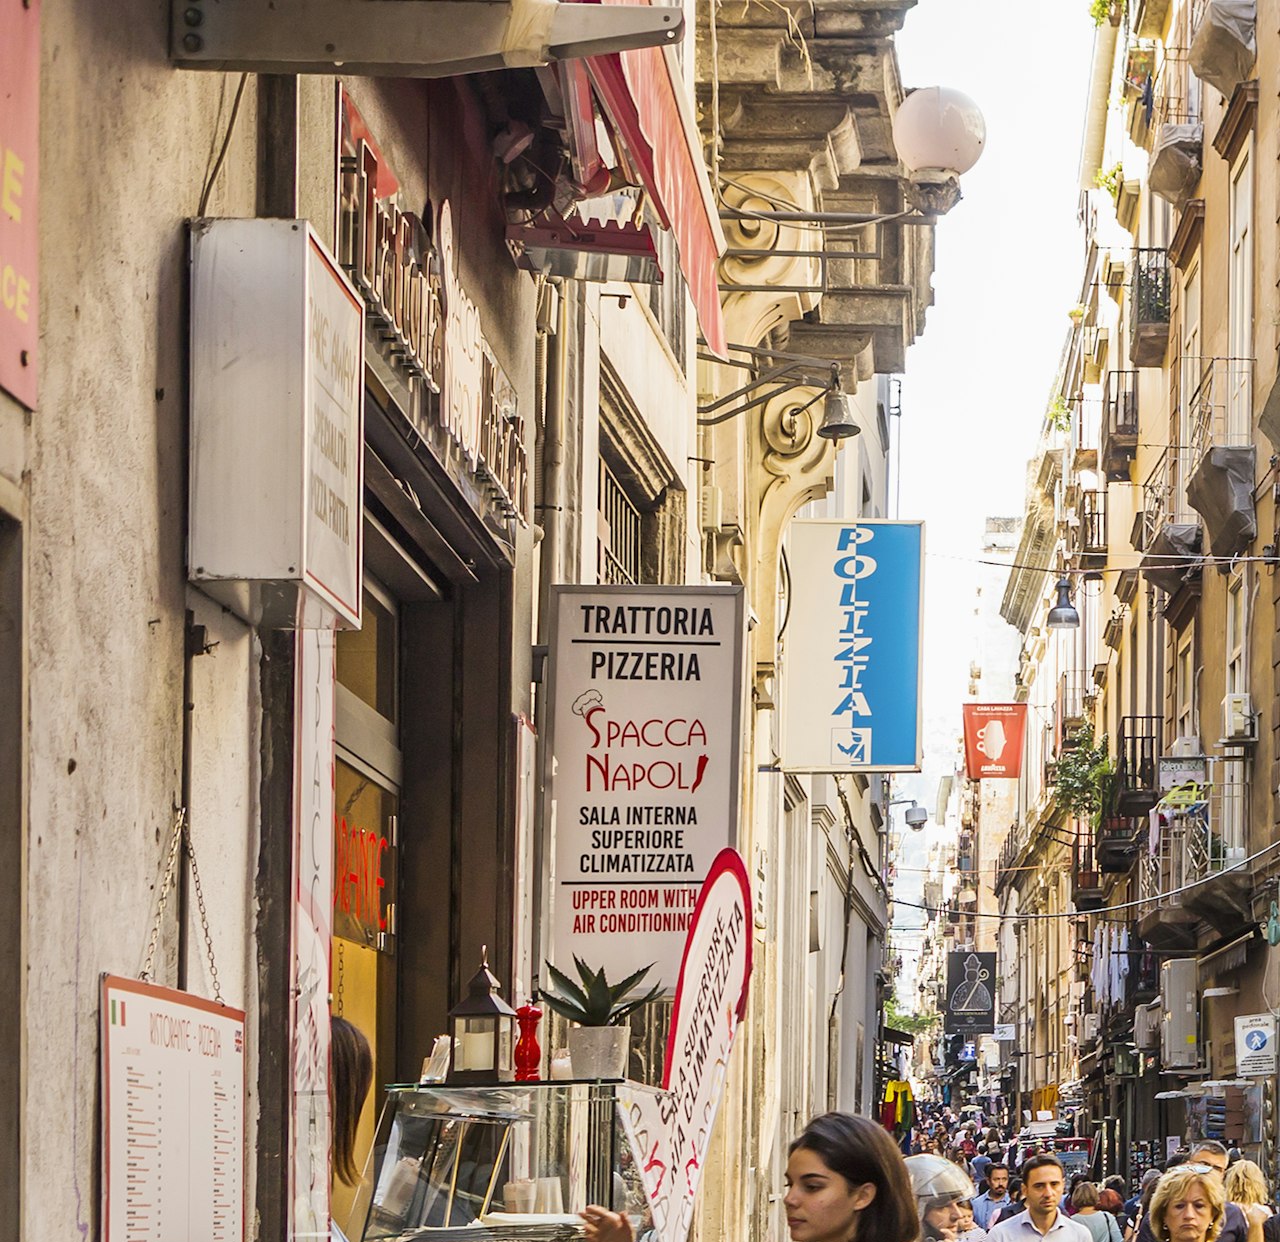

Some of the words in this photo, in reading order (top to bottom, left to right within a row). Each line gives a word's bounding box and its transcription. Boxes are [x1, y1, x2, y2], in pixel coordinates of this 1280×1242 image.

[332, 332, 357, 398] AWAY
[581, 605, 714, 636] TRATTORIA
[832, 528, 878, 717] POLIZIA
[591, 651, 701, 682] PIZZERIA
[586, 707, 708, 749] SPACCA
[586, 754, 710, 794] NAPOLI
[580, 806, 620, 826] SALA
[626, 806, 698, 826] INTERNA
[591, 830, 684, 850] SUPERIORE
[580, 854, 694, 873] CLIMATIZZATA
[572, 890, 616, 910] UPPER
[620, 889, 659, 909] ROOM
[663, 888, 697, 908] WITH
[573, 914, 595, 934] AIR
[684, 906, 726, 1070] SUPERIORE
[683, 899, 744, 1124] CLIMATIZZATA
[149, 1013, 191, 1053] RISTORANTE
